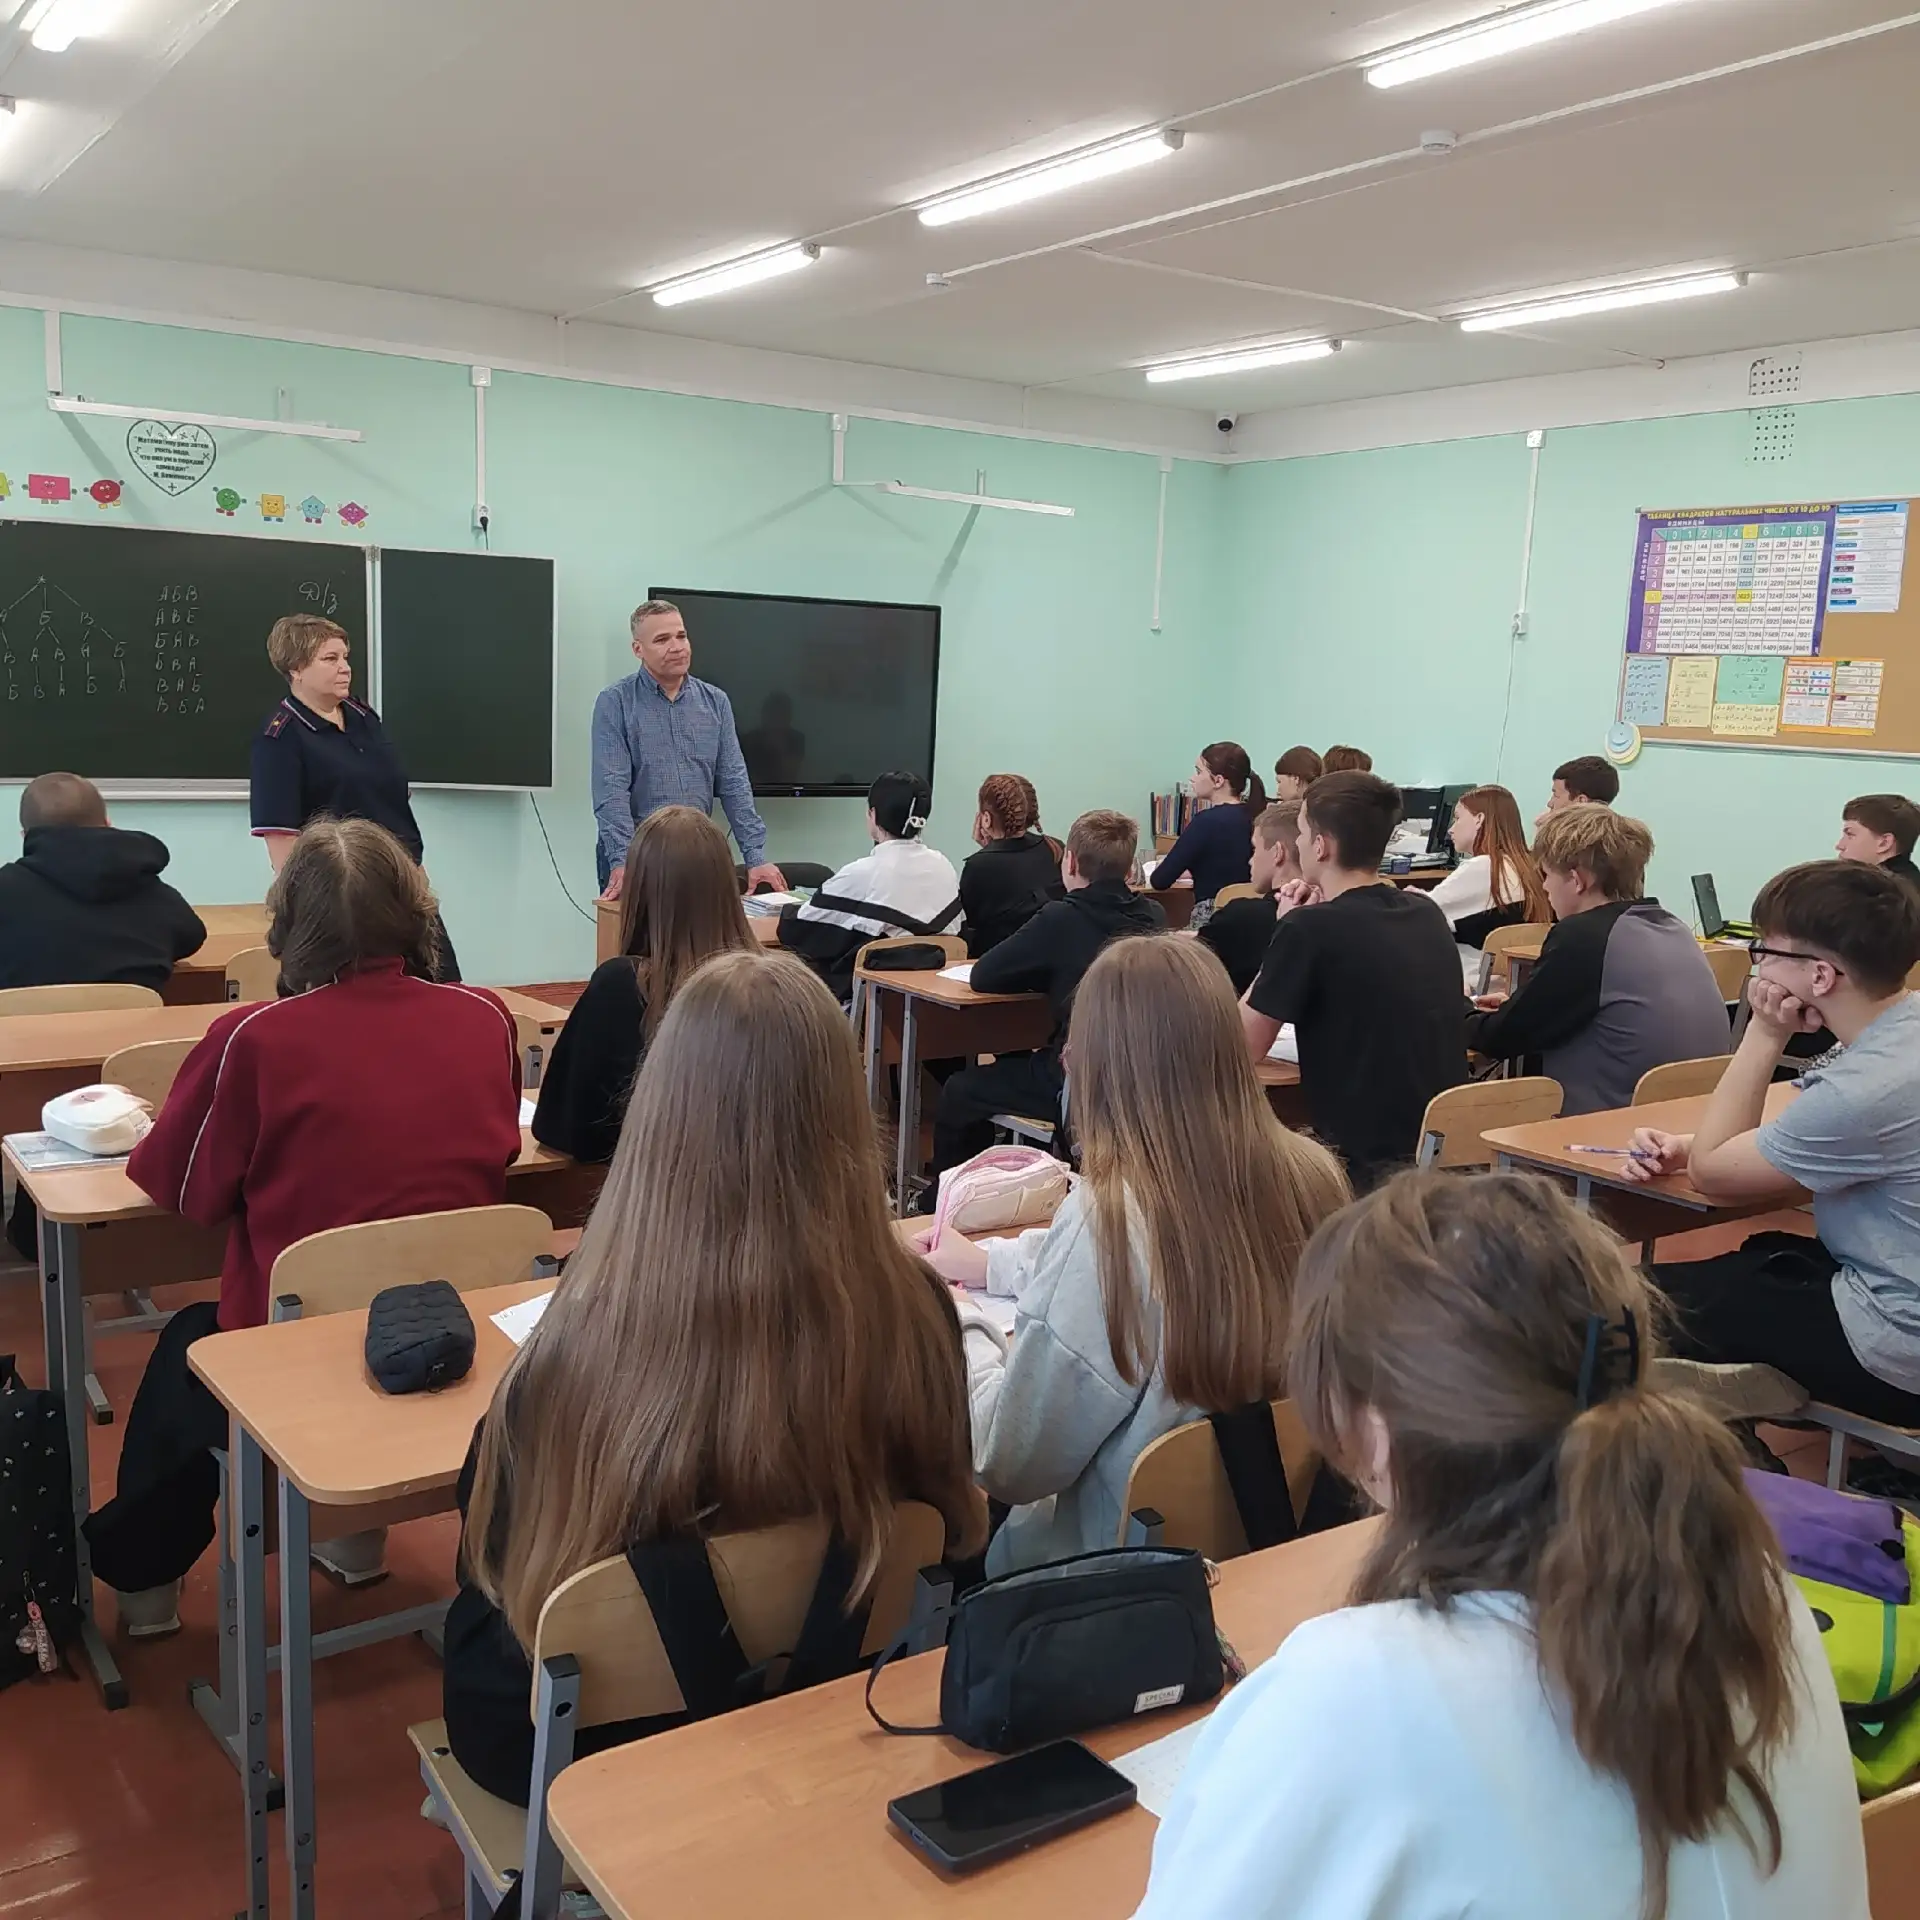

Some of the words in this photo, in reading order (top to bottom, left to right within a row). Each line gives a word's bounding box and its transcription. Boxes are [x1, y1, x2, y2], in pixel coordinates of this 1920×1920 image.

[1647, 512, 1675, 520] ТАБЛИЦА
[1677, 510, 1714, 519] КВАДРАТОВ
[1715, 508, 1763, 517] НАТУРАЛЬНЫХ
[1764, 506, 1788, 514] ЧИСЕЛ
[1808, 505, 1820, 514] ДО
[1672, 530, 1678, 540] 0
[1687, 530, 1692, 538] 1
[1701, 530, 1707, 538] 2
[1717, 529, 1722, 537] 3
[1733, 529, 1738, 537] 4
[1763, 526, 1769, 535] 6
[1780, 527, 1787, 535] 7
[1796, 526, 1802, 534] 8
[1813, 525, 1819, 534] 9
[1656, 544, 1660, 552] 1
[1654, 556, 1660, 564] 2
[1652, 570, 1658, 578] 3
[1652, 580, 1657, 588] 4
[1649, 606, 1655, 614] 6
[39, 611, 53, 625] Б
[80, 612, 94, 625] В
[1648, 617, 1654, 625] 7
[1647, 630, 1652, 638] 8
[1646, 642, 1651, 650] 9
[4, 651, 16, 664] В
[30, 647, 39, 662] А
[54, 648, 65, 661] В
[81, 643, 90, 658] А
[114, 641, 128, 657] Б
[8, 684, 19, 700] Б
[34, 685, 45, 698] В
[87, 676, 97, 694] Б
[1145, 1690, 1175, 1701] SPECIAL
